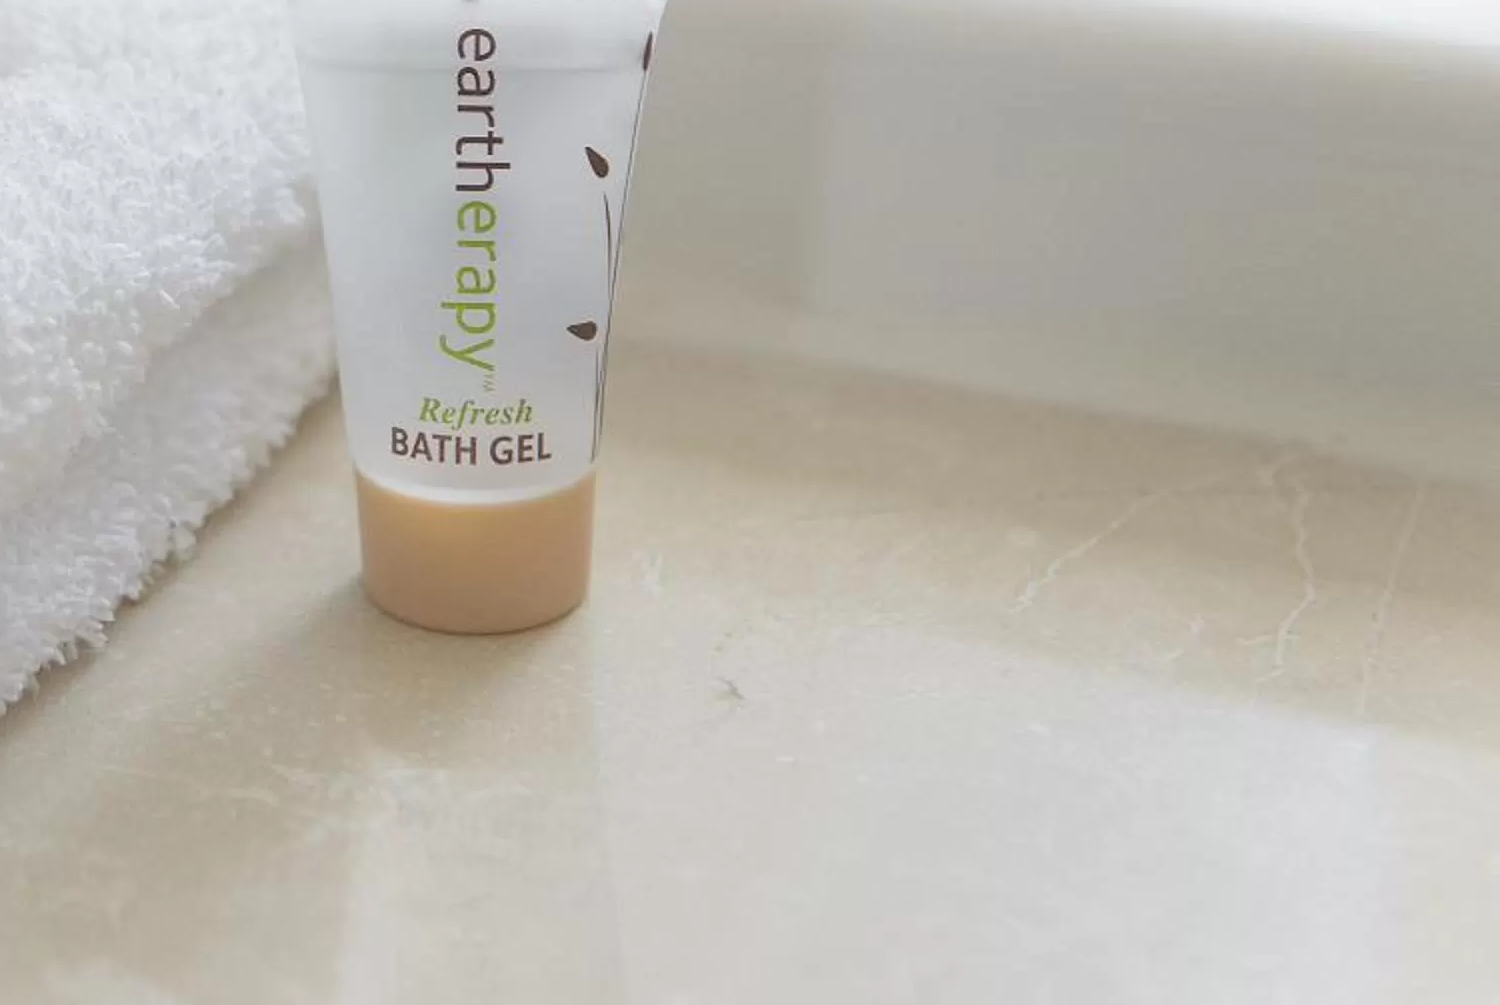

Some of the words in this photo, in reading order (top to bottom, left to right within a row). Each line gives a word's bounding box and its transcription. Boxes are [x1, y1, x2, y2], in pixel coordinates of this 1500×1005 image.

[439, 28, 511, 372] eartherapy
[419, 397, 534, 431] Refresh
[391, 427, 477, 465] BATH
[489, 432, 552, 465] GEL
